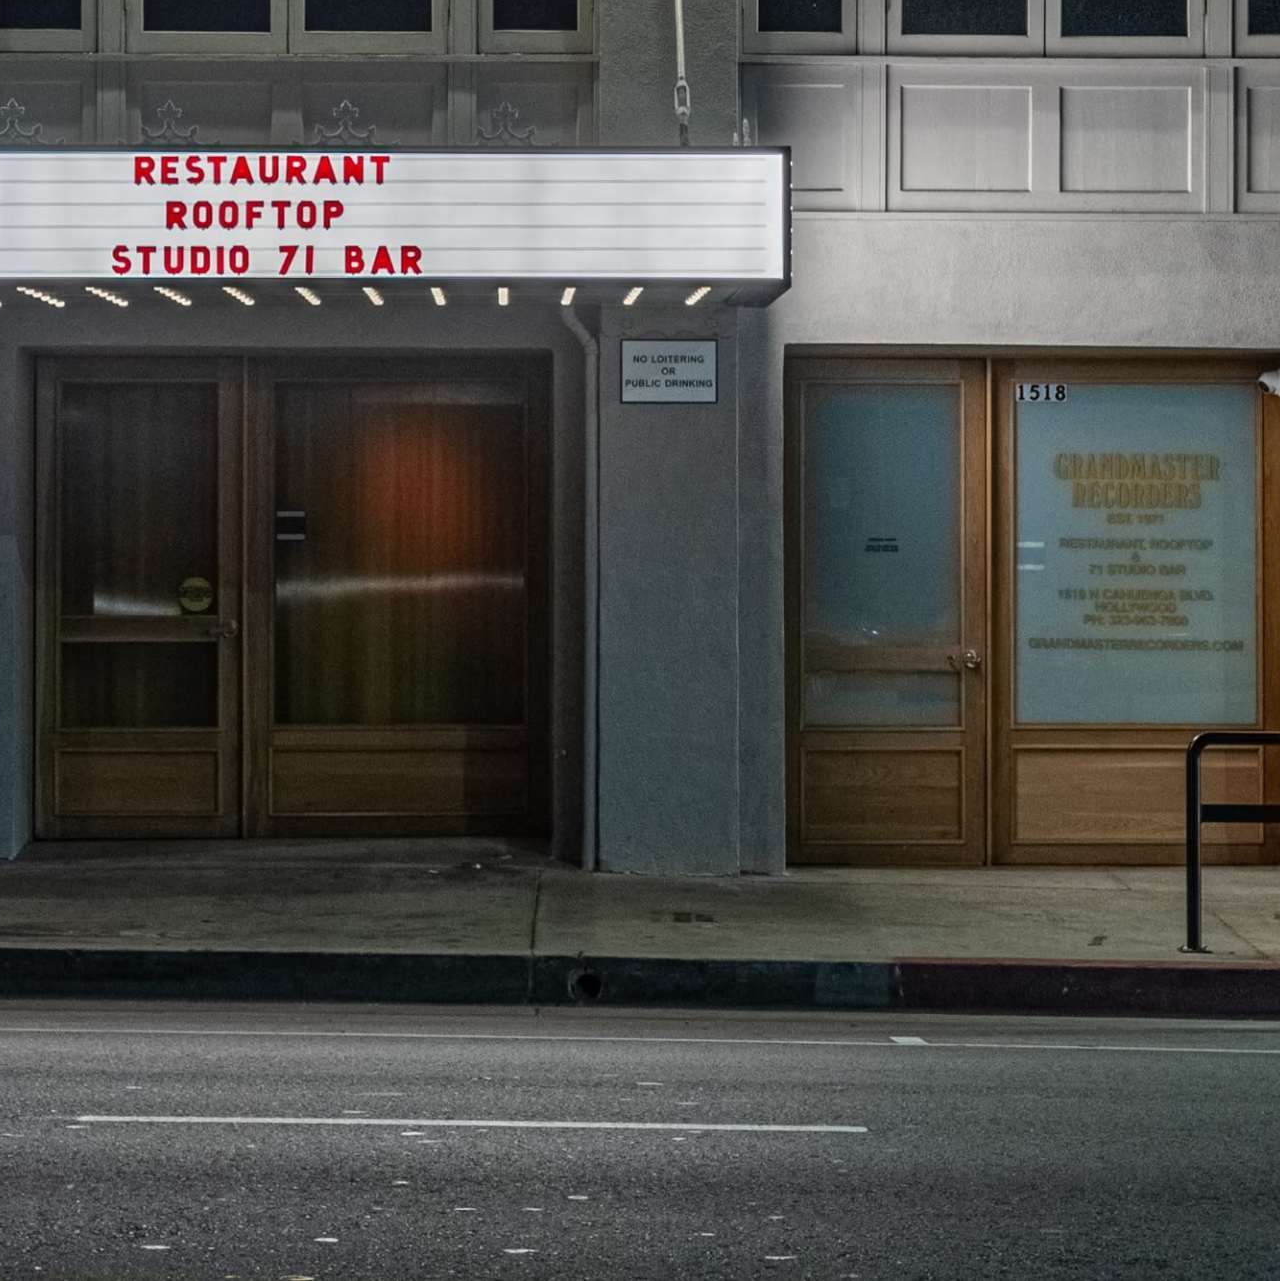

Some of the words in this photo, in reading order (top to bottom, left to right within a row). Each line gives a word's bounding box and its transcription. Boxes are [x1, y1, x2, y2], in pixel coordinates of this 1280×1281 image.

[133, 155, 391, 186] RESTAURANT
[165, 200, 345, 230] ROOFTOP
[111, 245, 250, 275] STUDIO
[344, 245, 424, 275] BAR
[632, 354, 648, 364] NO
[651, 354, 705, 364] LOITERING
[660, 367, 676, 376] OR
[625, 379, 661, 388] PUBLIC
[664, 379, 714, 388] DRINKING
[1017, 384, 1067, 401] 1518
